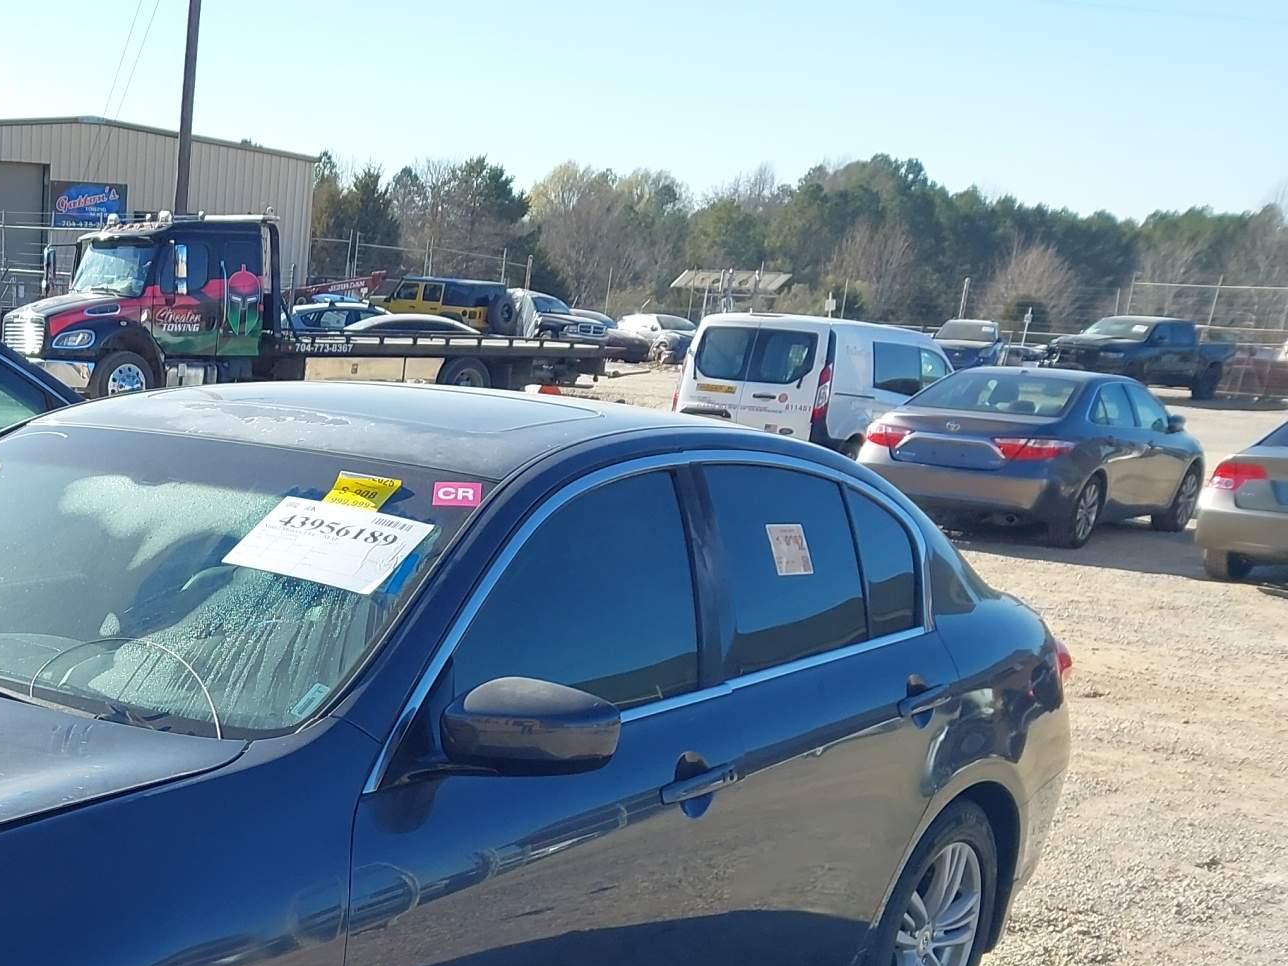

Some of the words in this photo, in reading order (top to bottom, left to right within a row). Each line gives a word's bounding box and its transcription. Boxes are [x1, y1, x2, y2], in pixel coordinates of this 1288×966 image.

[162, 323, 201, 332] TOWING
[295, 343, 354, 352] 704-773-8367
[354, 489, 379, 500] 908
[437, 487, 474, 501] CR
[279, 514, 399, 547] 43956189
